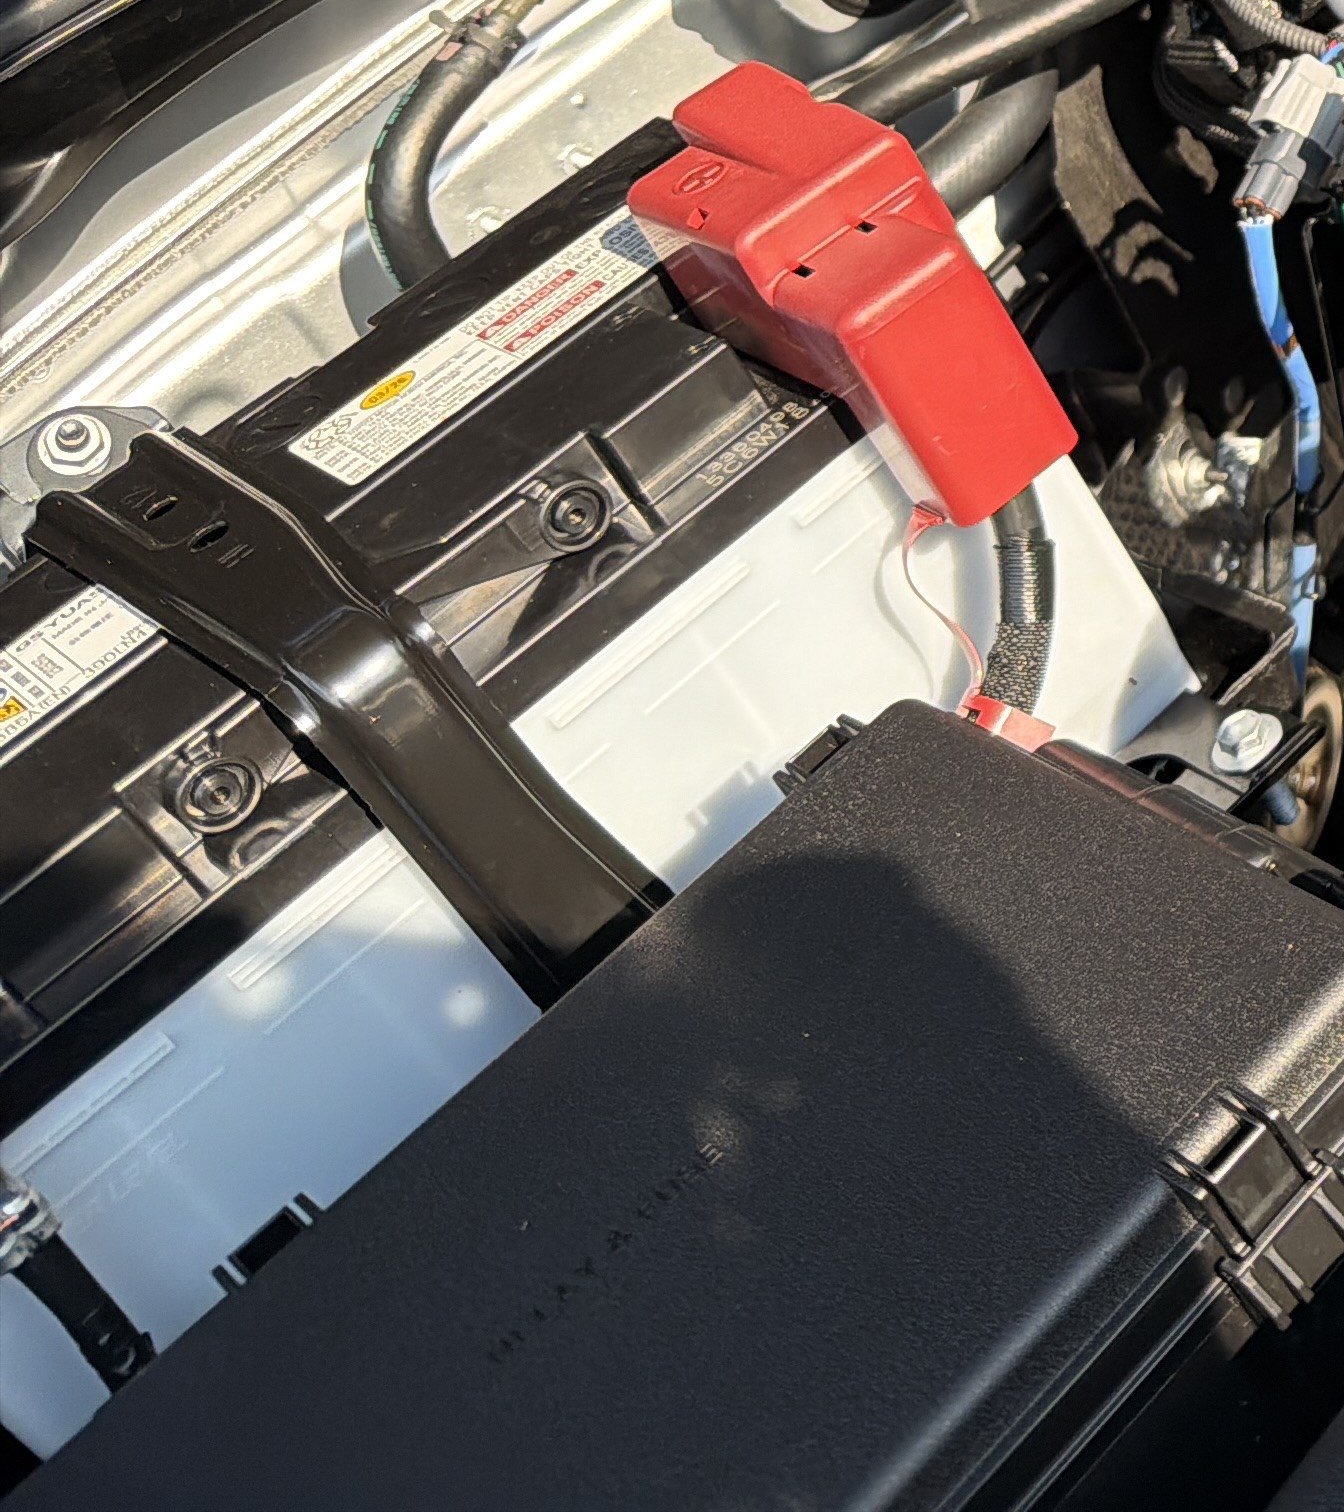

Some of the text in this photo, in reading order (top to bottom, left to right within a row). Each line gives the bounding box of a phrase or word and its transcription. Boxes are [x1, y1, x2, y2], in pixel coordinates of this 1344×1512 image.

[502, 271, 574, 324] DANGER
[528, 281, 599, 335] POISON
[43, 590, 99, 628] YUAS
